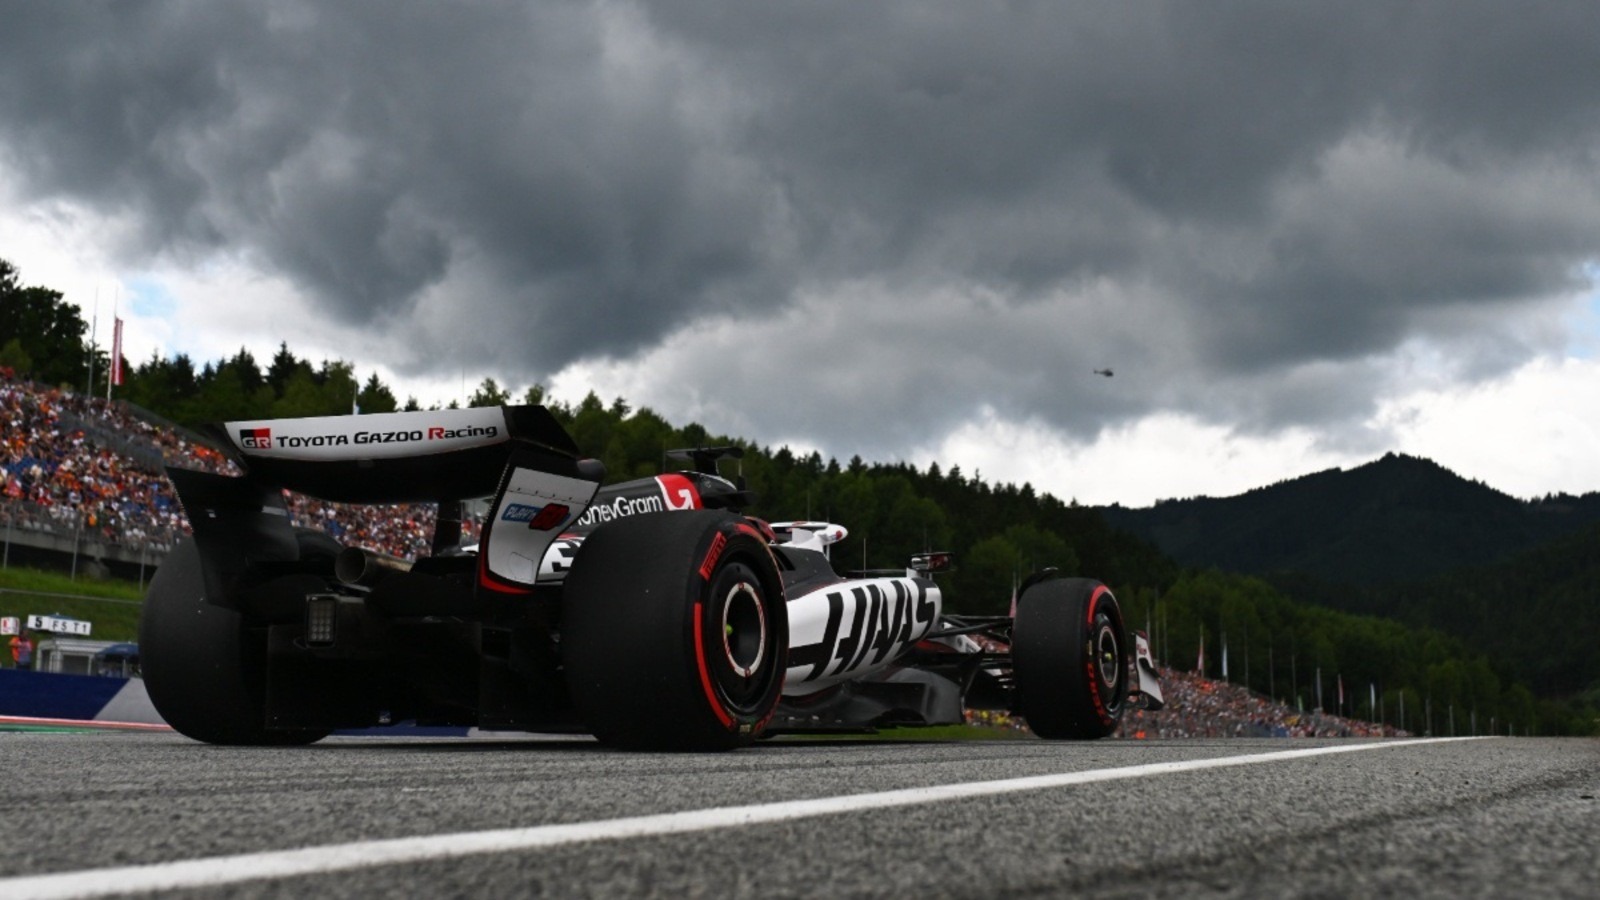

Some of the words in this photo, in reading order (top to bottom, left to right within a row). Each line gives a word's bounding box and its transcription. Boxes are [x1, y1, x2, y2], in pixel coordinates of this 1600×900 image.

[241, 434, 271, 449] GR
[275, 435, 349, 448] TOYOTA
[353, 430, 423, 444] GAZOO
[427, 425, 498, 440] Racing
[578, 496, 663, 526] oneyGram
